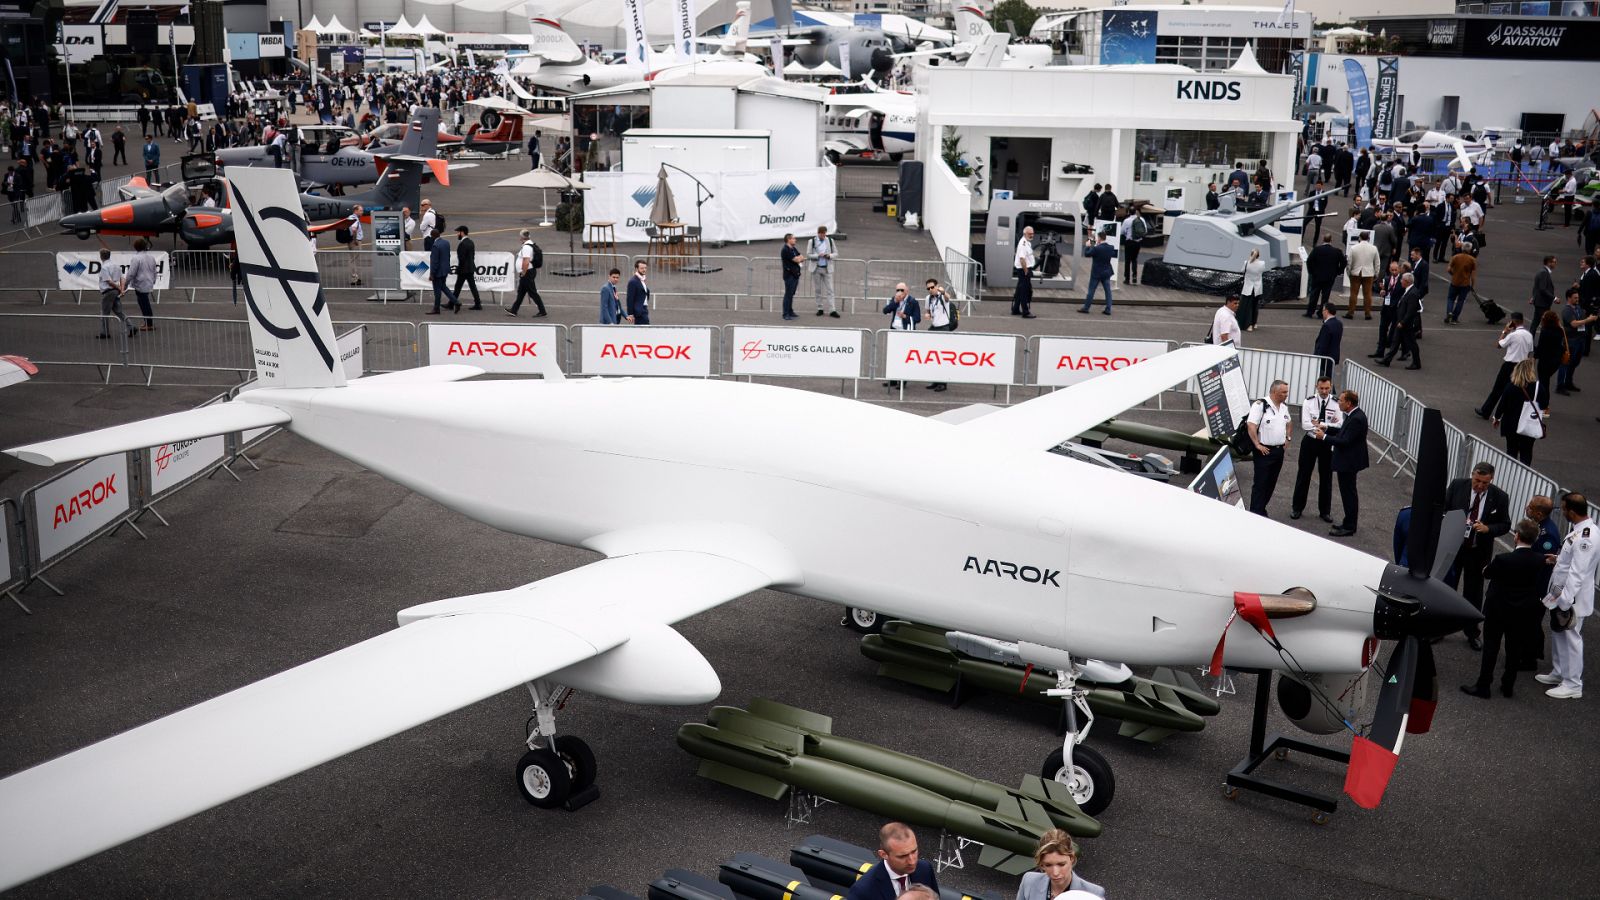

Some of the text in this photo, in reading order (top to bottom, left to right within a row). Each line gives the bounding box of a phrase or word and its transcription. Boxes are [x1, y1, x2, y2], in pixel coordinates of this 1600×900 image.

[969, 22, 984, 36] 8X
[1503, 26, 1567, 37] DASSAULT
[260, 37, 283, 45] MBDA
[1501, 37, 1560, 47] AVIATION
[1177, 80, 1241, 101] KNDS
[331, 157, 366, 167] OE-VHS
[302, 203, 341, 216] -FYY
[759, 212, 806, 224] Diamond
[447, 341, 538, 357] AAROK
[600, 343, 692, 360] AAROK
[767, 344, 854, 354] TURGIS & GAILLARD
[904, 349, 996, 367] AAROK
[1056, 356, 1148, 371] AARO
[54, 473, 116, 529] AAROK
[963, 556, 1060, 587] AAROK
